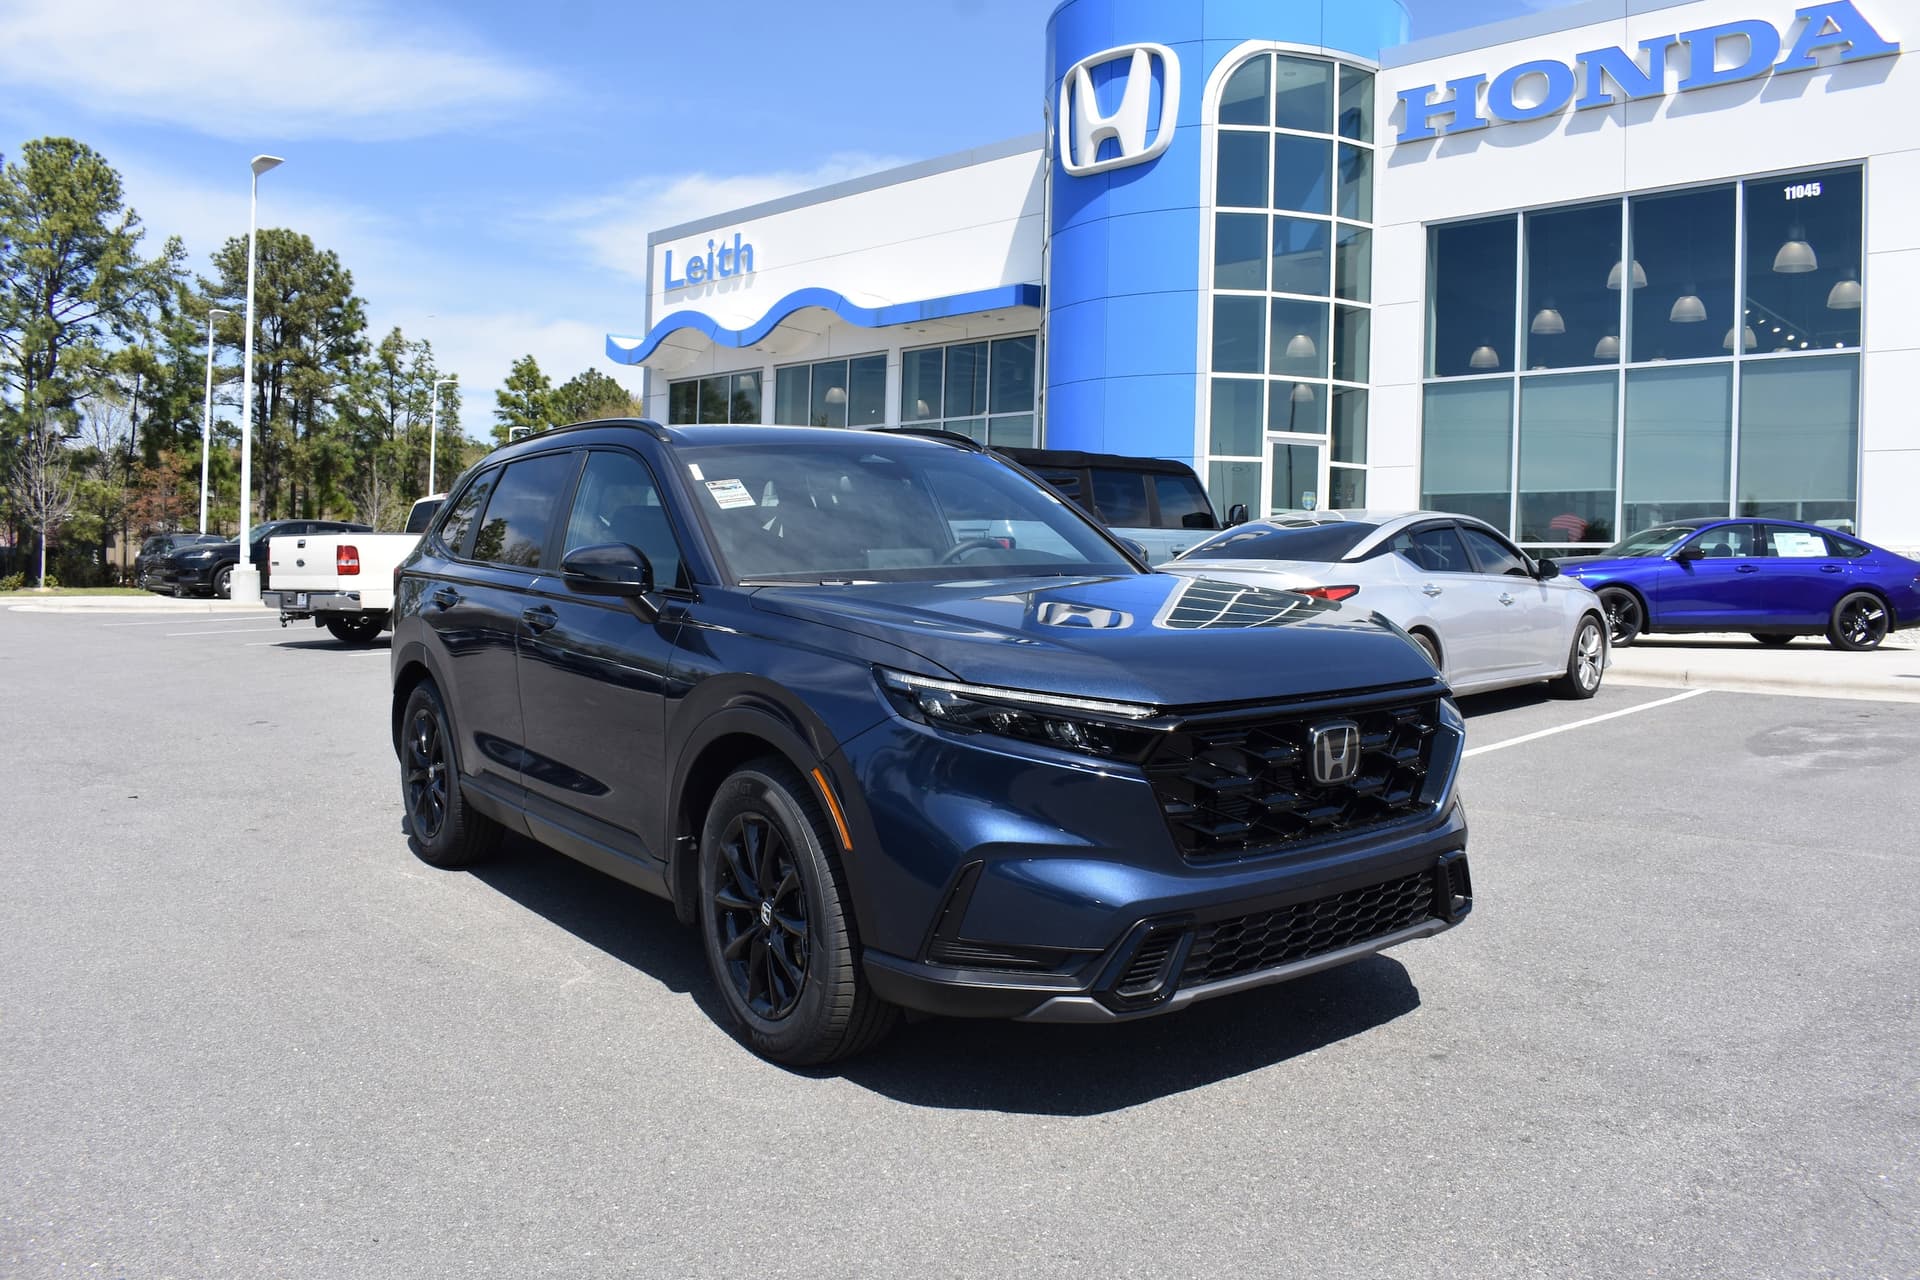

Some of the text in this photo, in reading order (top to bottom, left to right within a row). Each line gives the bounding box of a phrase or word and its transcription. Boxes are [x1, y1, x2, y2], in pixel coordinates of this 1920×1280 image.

[1396, 0, 1900, 143] HONDA
[1784, 182, 1821, 200] 11045
[664, 232, 754, 292] Leith
